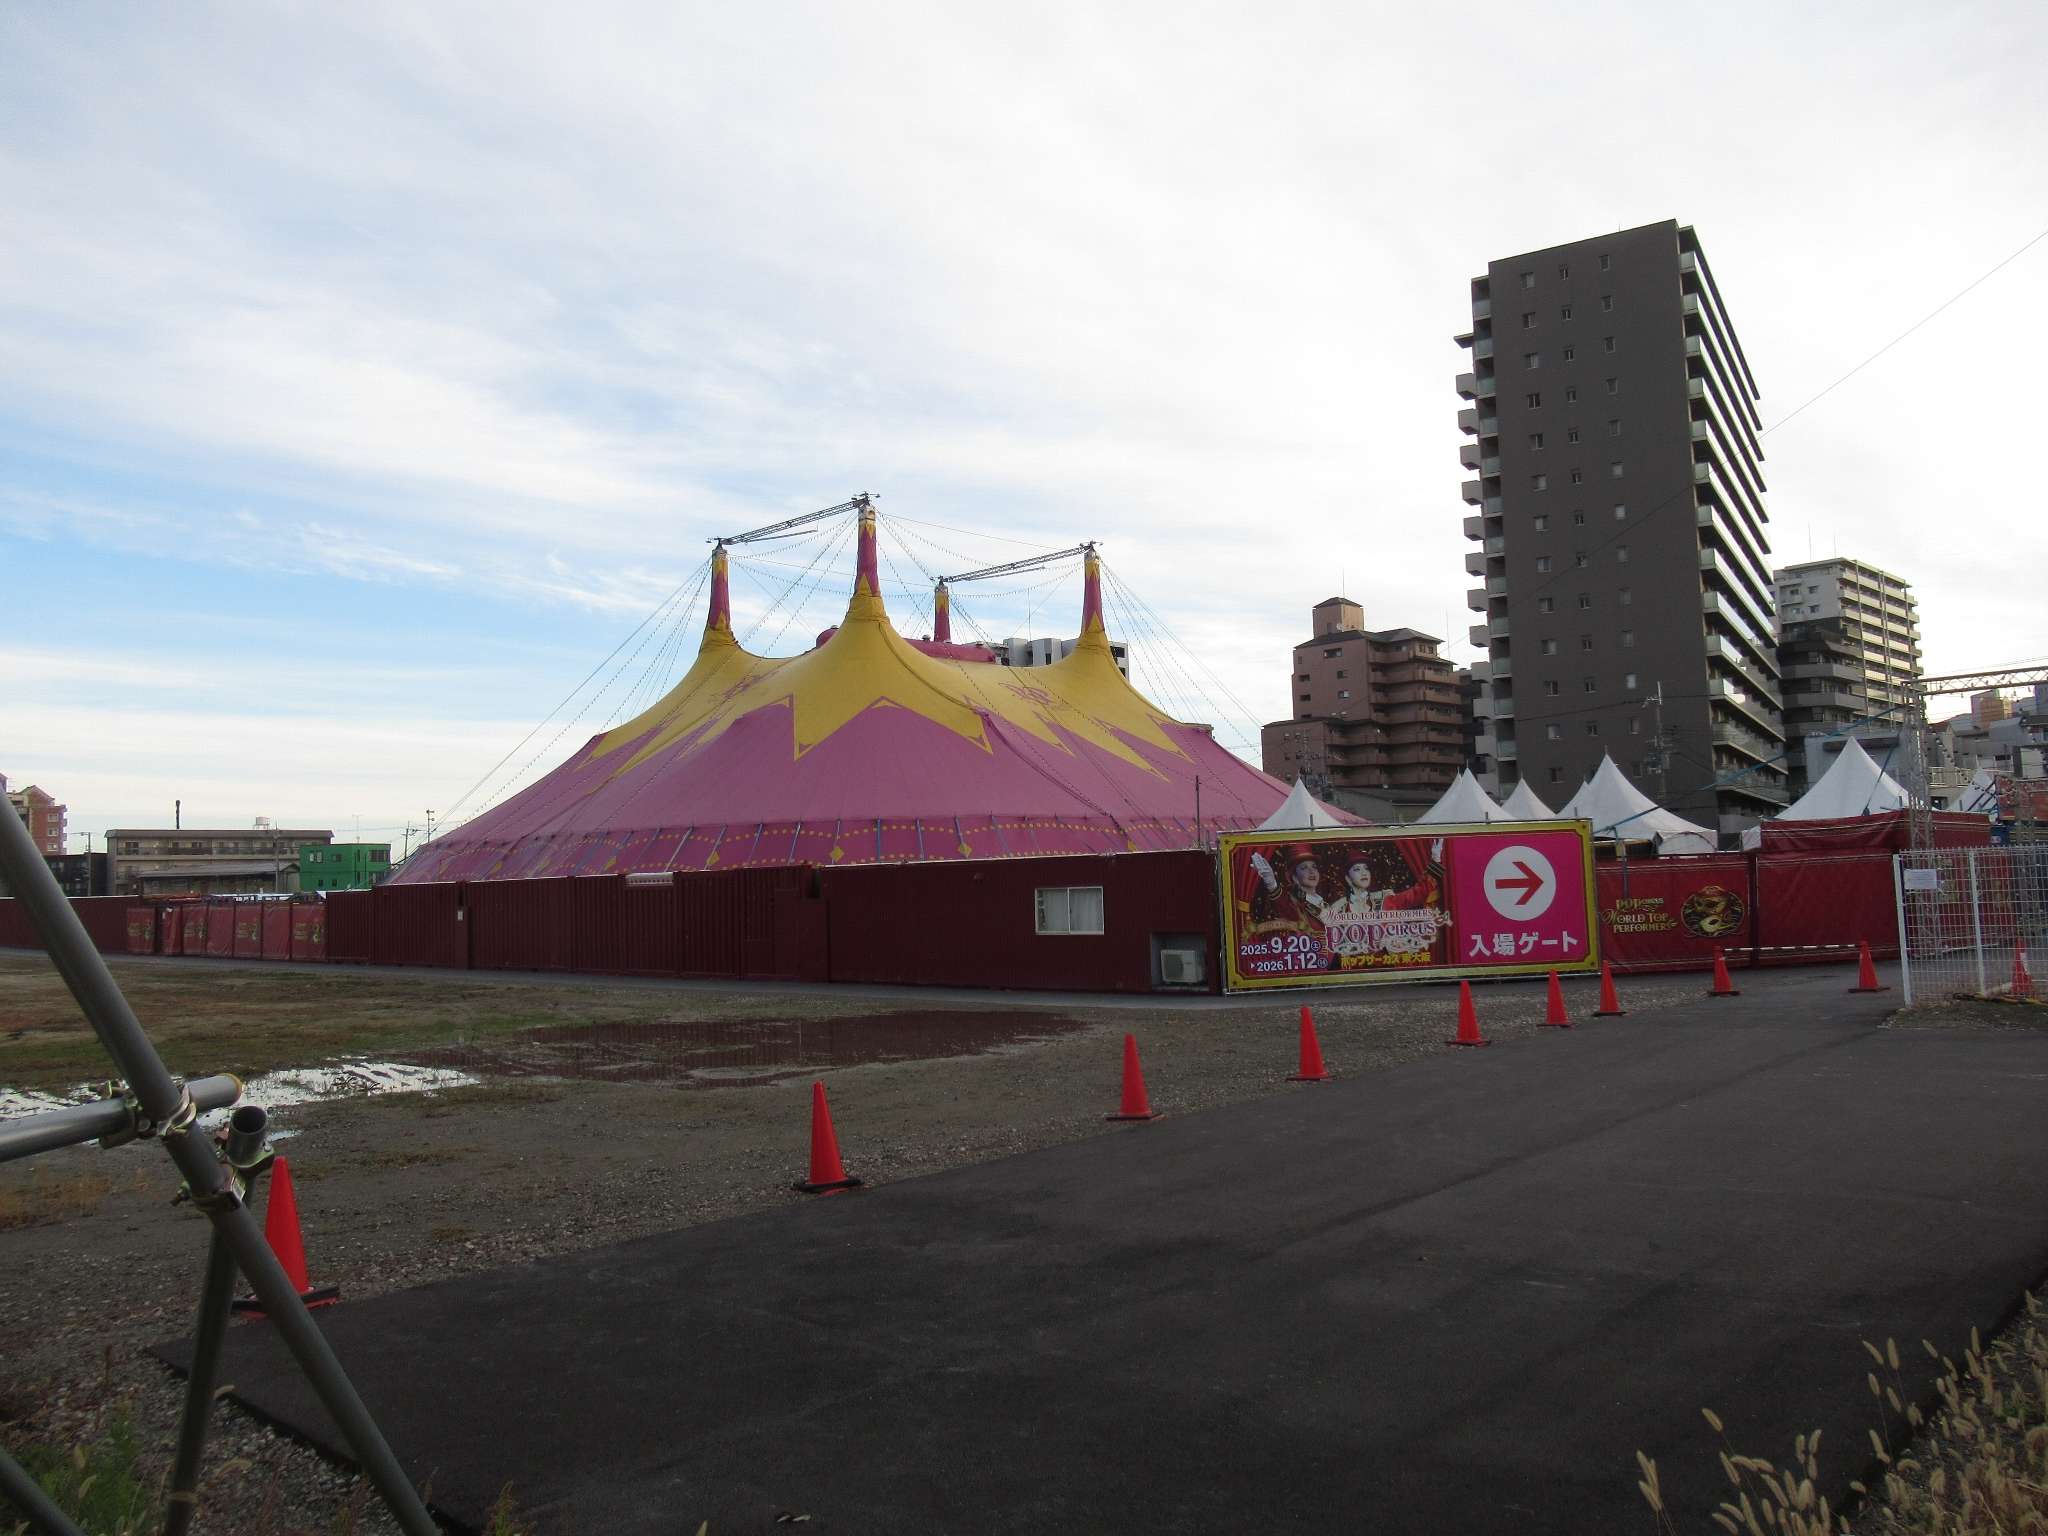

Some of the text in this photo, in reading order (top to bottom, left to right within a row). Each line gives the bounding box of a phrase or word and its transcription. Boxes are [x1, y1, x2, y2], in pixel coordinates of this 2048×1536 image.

[1602, 909, 1669, 924] WORLD TOP
[1386, 920, 1436, 937] CIRCUS
[1469, 930, 1578, 957] 入場ゲート
